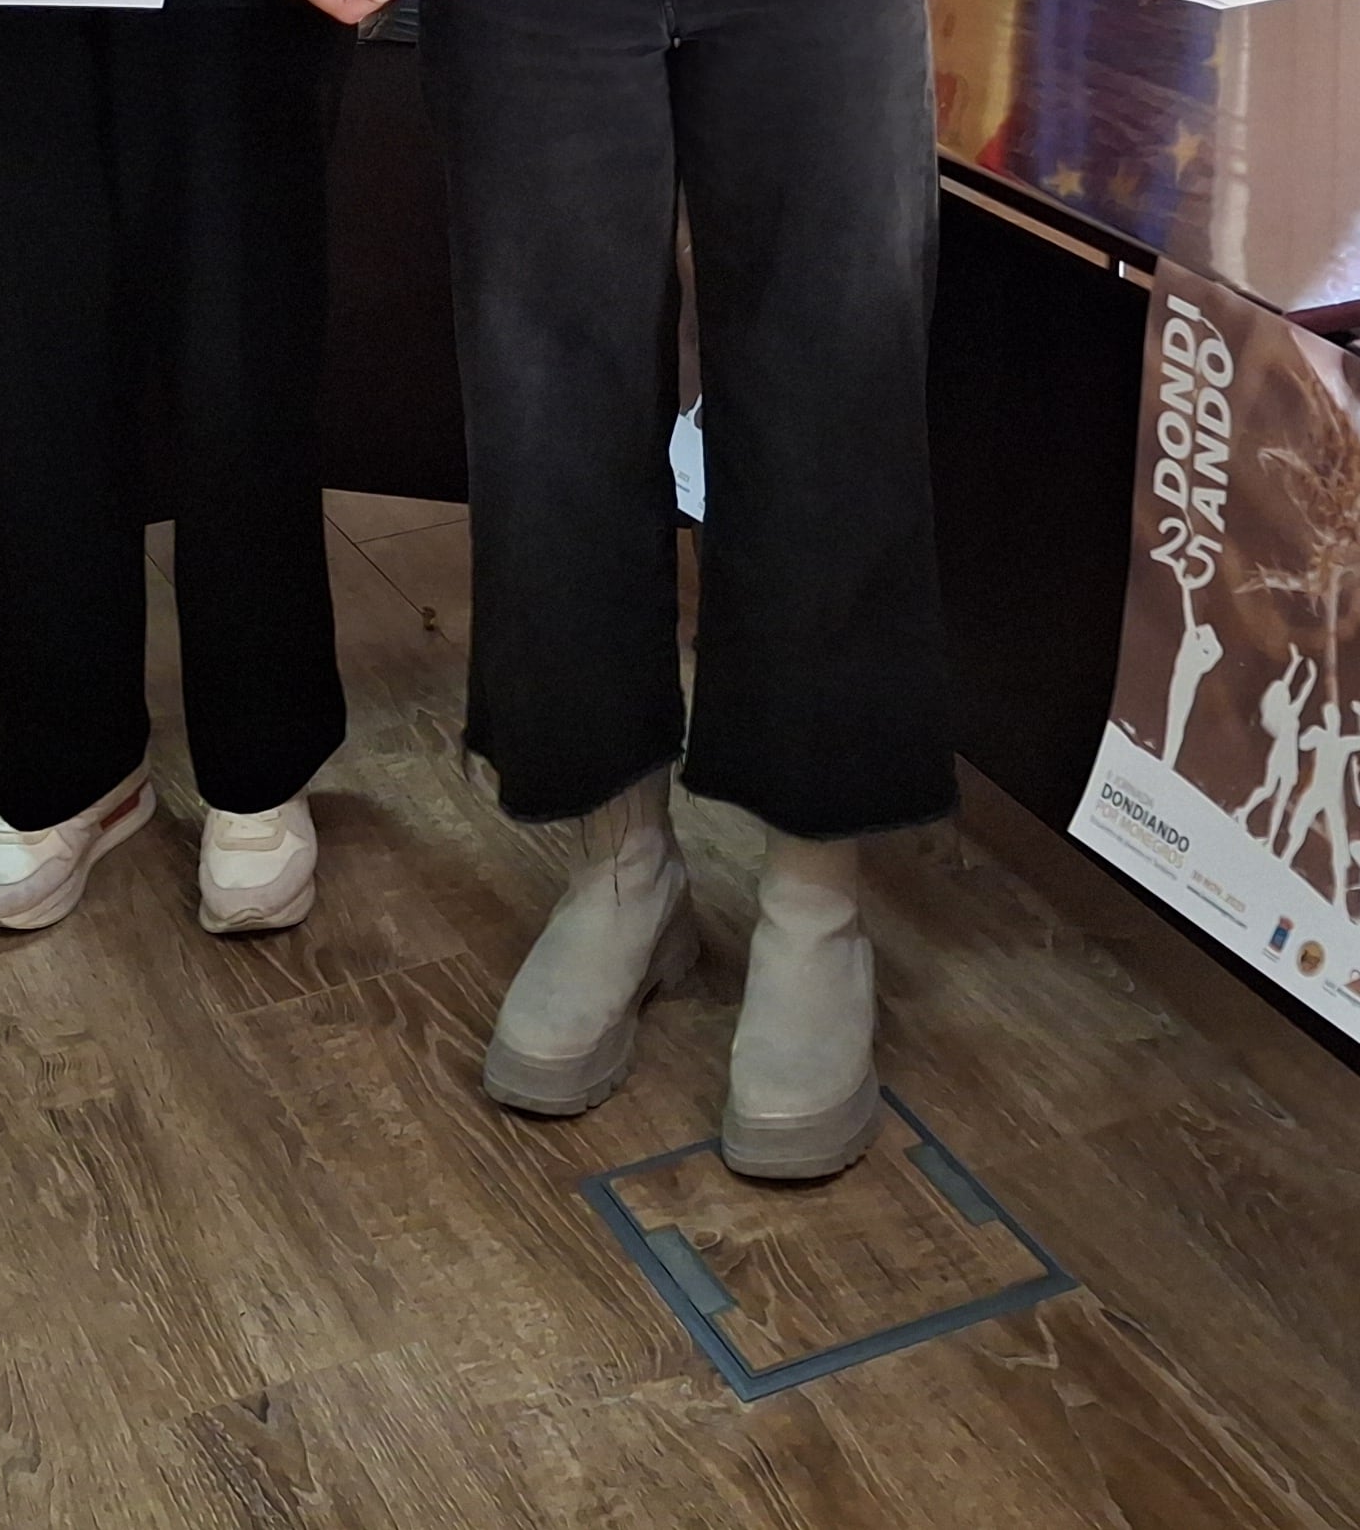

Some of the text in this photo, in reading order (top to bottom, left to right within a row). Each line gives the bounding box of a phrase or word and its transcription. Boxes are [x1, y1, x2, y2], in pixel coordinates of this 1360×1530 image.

[1153, 295, 1201, 509] DONDI
[1189, 341, 1235, 532] ANDO
[1101, 783, 1190, 853] DONDIANDO
